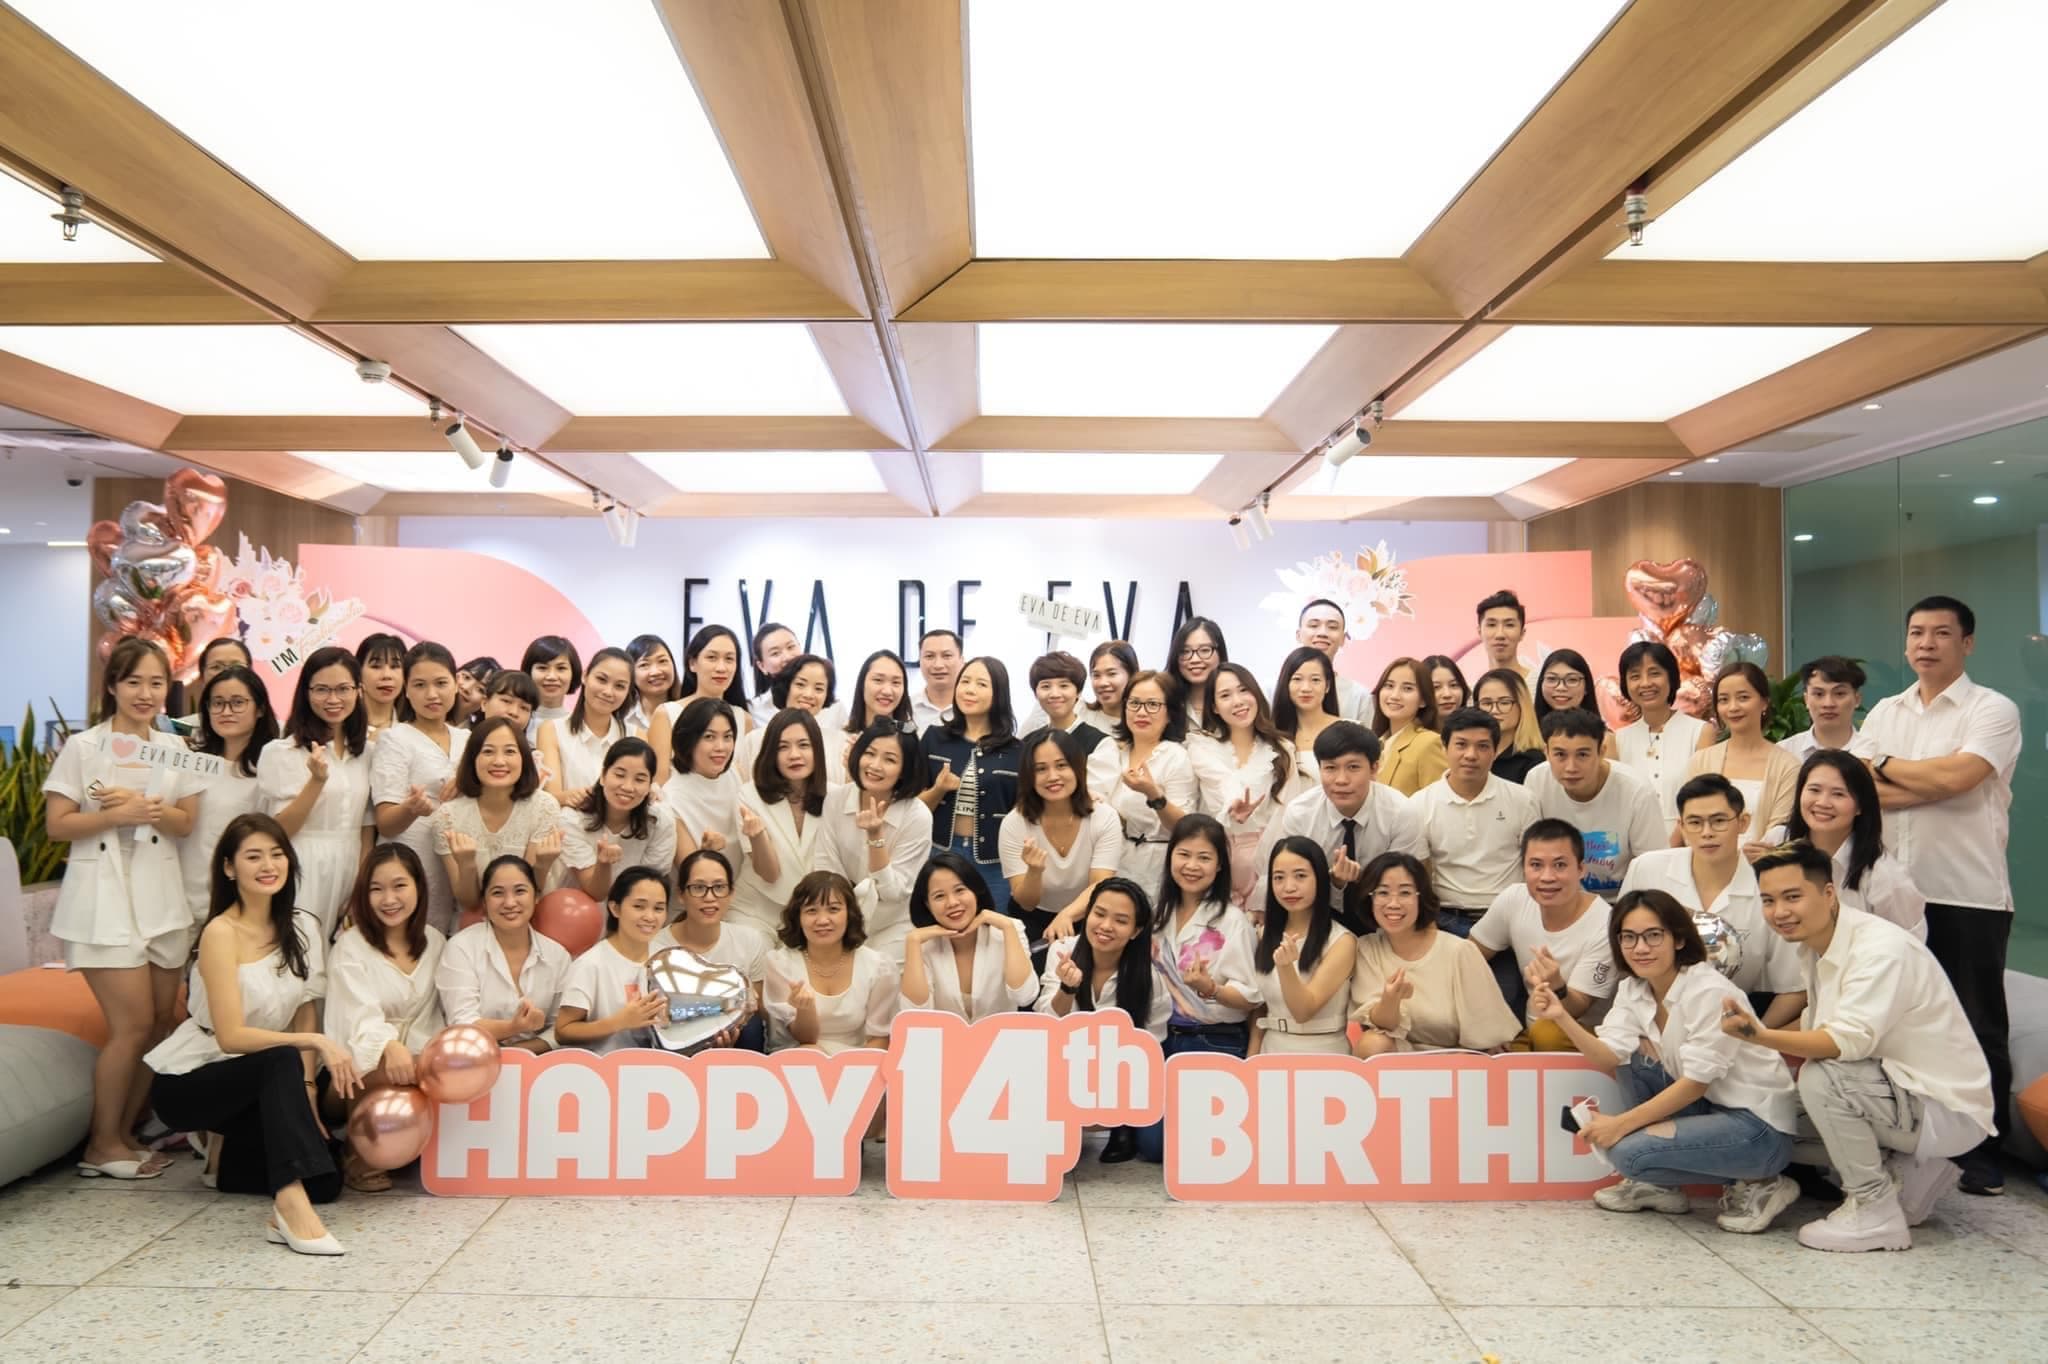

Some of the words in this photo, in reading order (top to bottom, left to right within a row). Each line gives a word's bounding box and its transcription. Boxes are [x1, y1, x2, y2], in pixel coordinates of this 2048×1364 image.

[683, 578, 836, 668] EVA
[899, 579, 982, 668] DE
[1020, 595, 1045, 617] EVA
[1052, 603, 1069, 622] DE
[1074, 608, 1100, 631] EVA
[271, 648, 299, 673] I'M
[140, 745, 166, 764] EVA
[173, 752, 188, 769] DE
[195, 757, 219, 775] EVA
[436, 1063, 881, 1180] HAPPY
[897, 1024, 1151, 1185] 14th
